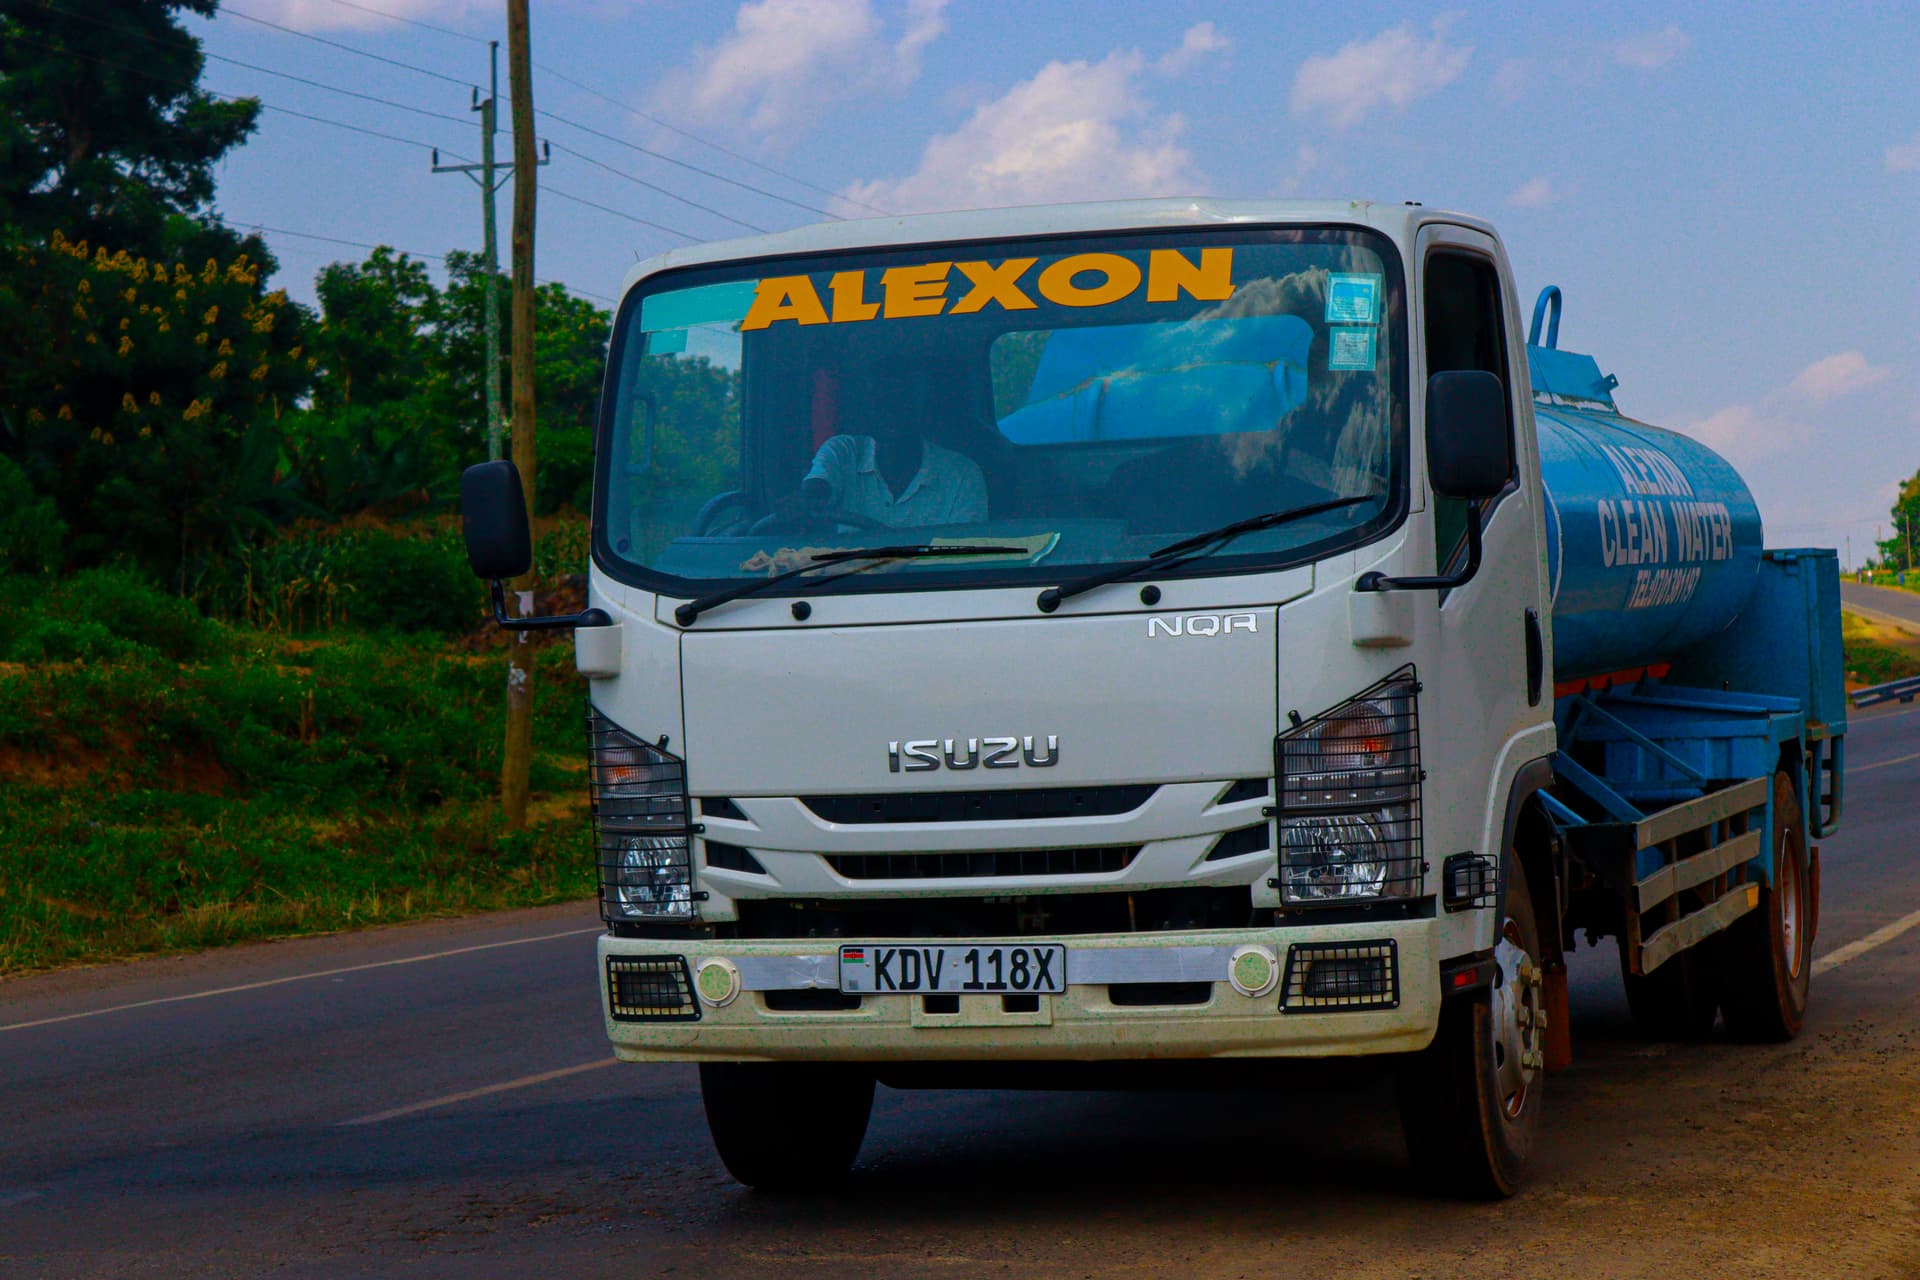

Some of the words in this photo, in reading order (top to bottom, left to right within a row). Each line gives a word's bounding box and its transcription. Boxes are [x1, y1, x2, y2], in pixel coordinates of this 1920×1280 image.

[740, 248, 1236, 332] ALEXON
[1600, 444, 1695, 497] ALEXON
[1598, 500, 1668, 567] CLEAN
[1669, 501, 1733, 562] WATER
[1147, 613, 1259, 638] NQR
[888, 735, 1059, 773] ISUZU
[874, 948, 945, 991] KDV
[963, 948, 1055, 991] 118X
